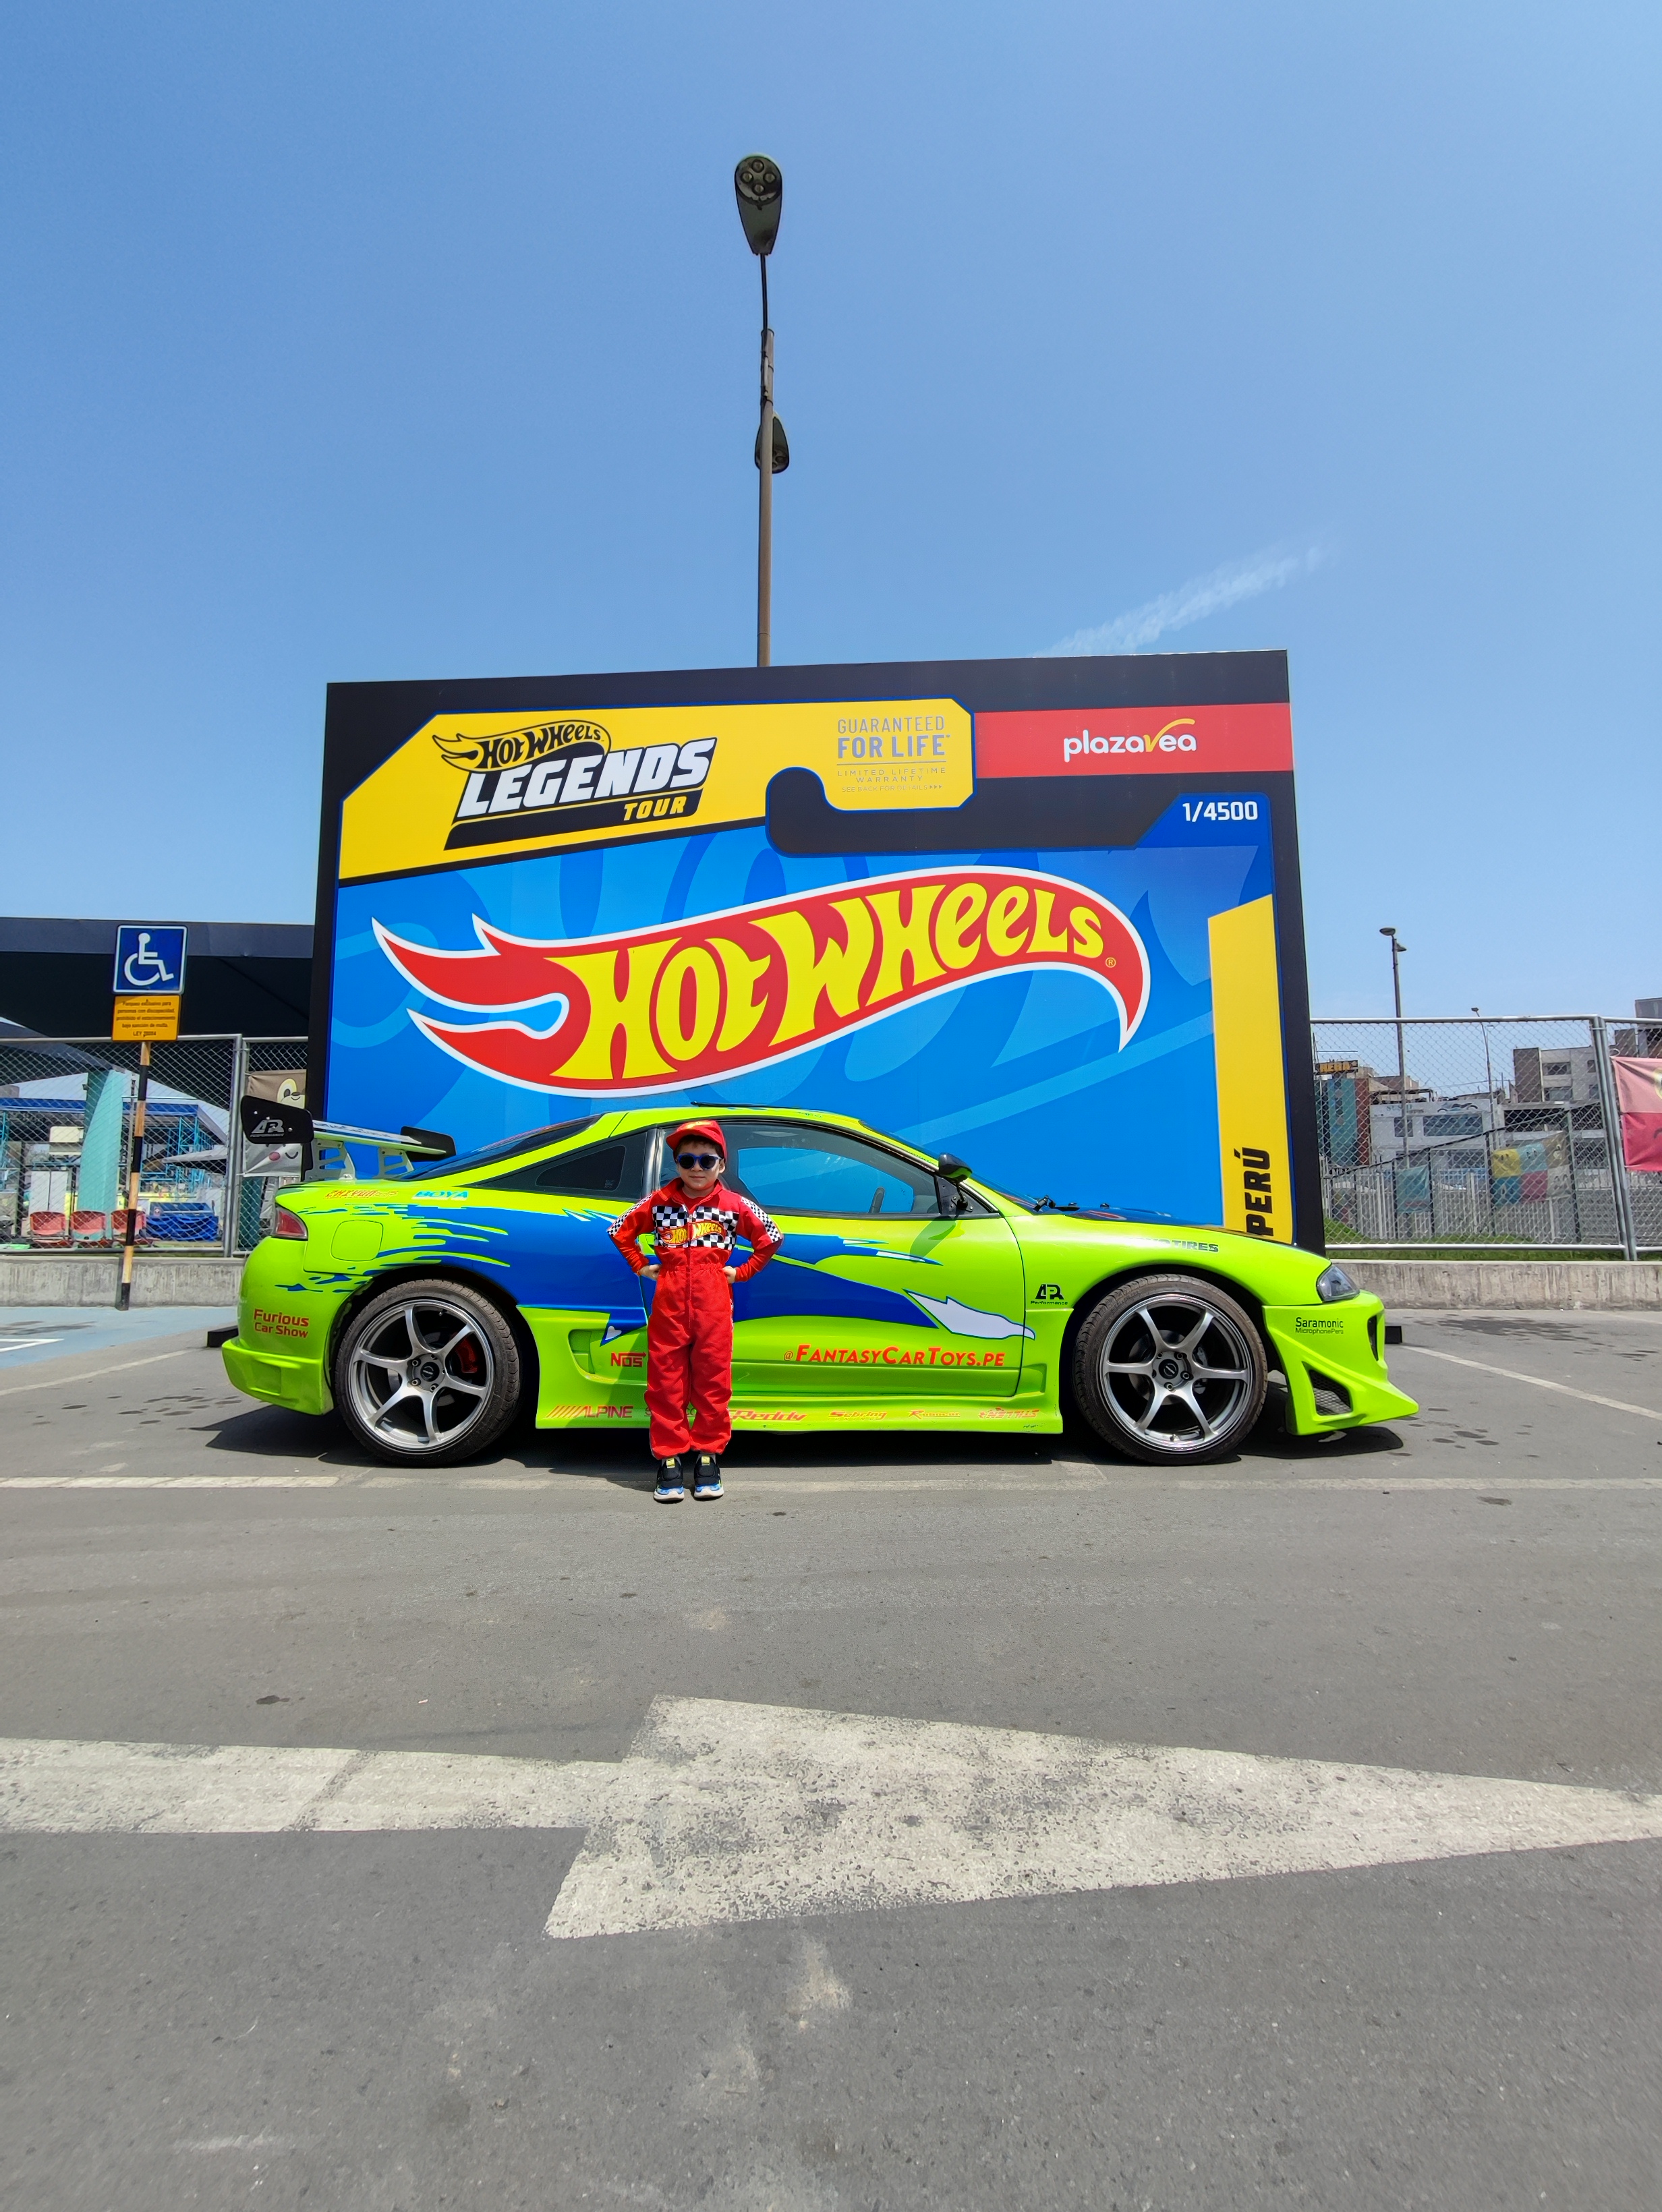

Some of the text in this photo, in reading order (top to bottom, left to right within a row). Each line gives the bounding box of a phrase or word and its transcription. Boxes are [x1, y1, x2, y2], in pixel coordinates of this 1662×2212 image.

[837, 716, 944, 734] GUARANTEED
[838, 736, 883, 759] FOR
[457, 738, 716, 818] LEGENDS
[837, 767, 946, 777] LIMITED LIFETIME
[623, 795, 687, 821] TOUR
[1182, 801, 1259, 823] 1/4500
[413, 1190, 469, 1200] BOYA
[1233, 1146, 1274, 1237] PERÚ
[1172, 1240, 1219, 1253] TIRES
[254, 1308, 310, 1328] Furious
[1295, 1316, 1344, 1329] Saramonic
[254, 1322, 309, 1339] Car Show
[610, 1351, 647, 1368] NOS
[828, 1410, 888, 1420] Sebring
[908, 1409, 961, 1420] Robocar
